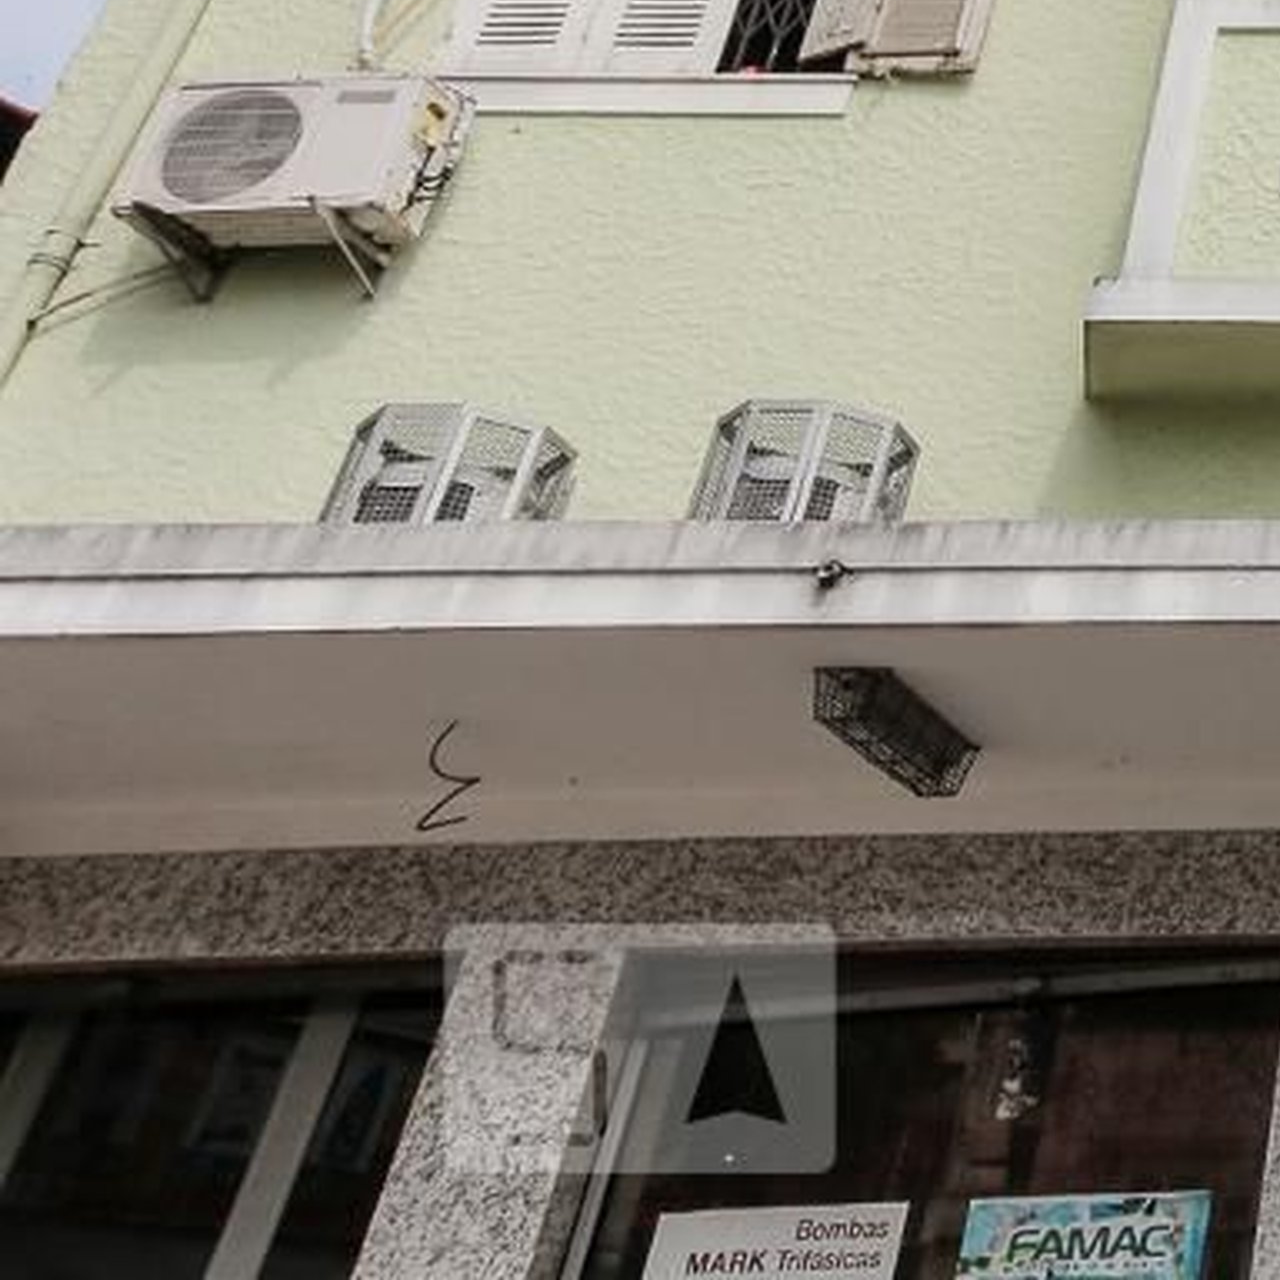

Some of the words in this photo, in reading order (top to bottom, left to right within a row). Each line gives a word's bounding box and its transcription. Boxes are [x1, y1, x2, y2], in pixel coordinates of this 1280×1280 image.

[795, 1217, 890, 1241] Bombas
[1006, 1223, 1171, 1262] FAMAC
[686, 1249, 769, 1275] MARK
